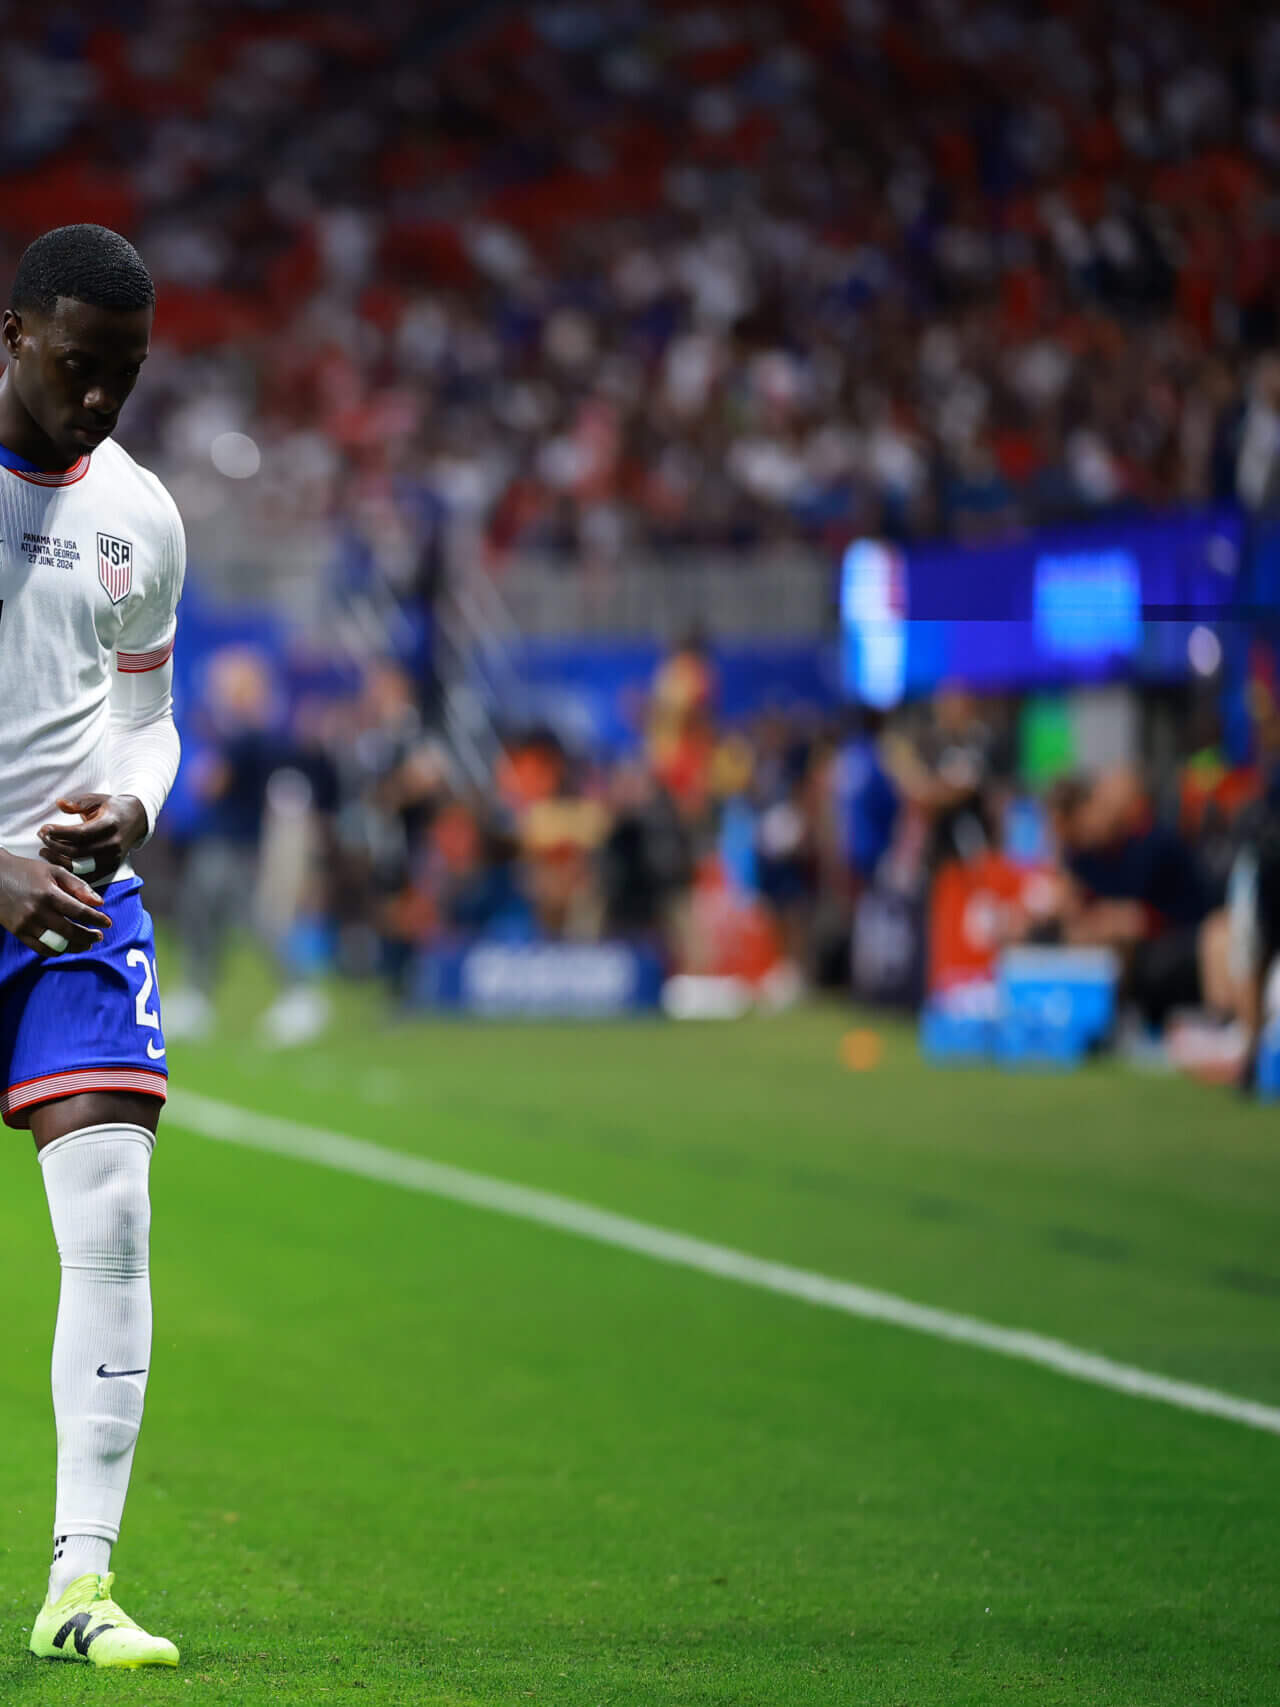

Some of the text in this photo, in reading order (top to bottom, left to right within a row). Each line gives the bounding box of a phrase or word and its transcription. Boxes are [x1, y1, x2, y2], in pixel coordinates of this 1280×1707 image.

[23, 533, 51, 545] PANAMA
[64, 540, 77, 550] USA
[53, 548, 80, 561] GEORGIA
[100, 537, 129, 566] USA
[27, 554, 73, 570] 27 JUNE 2024
